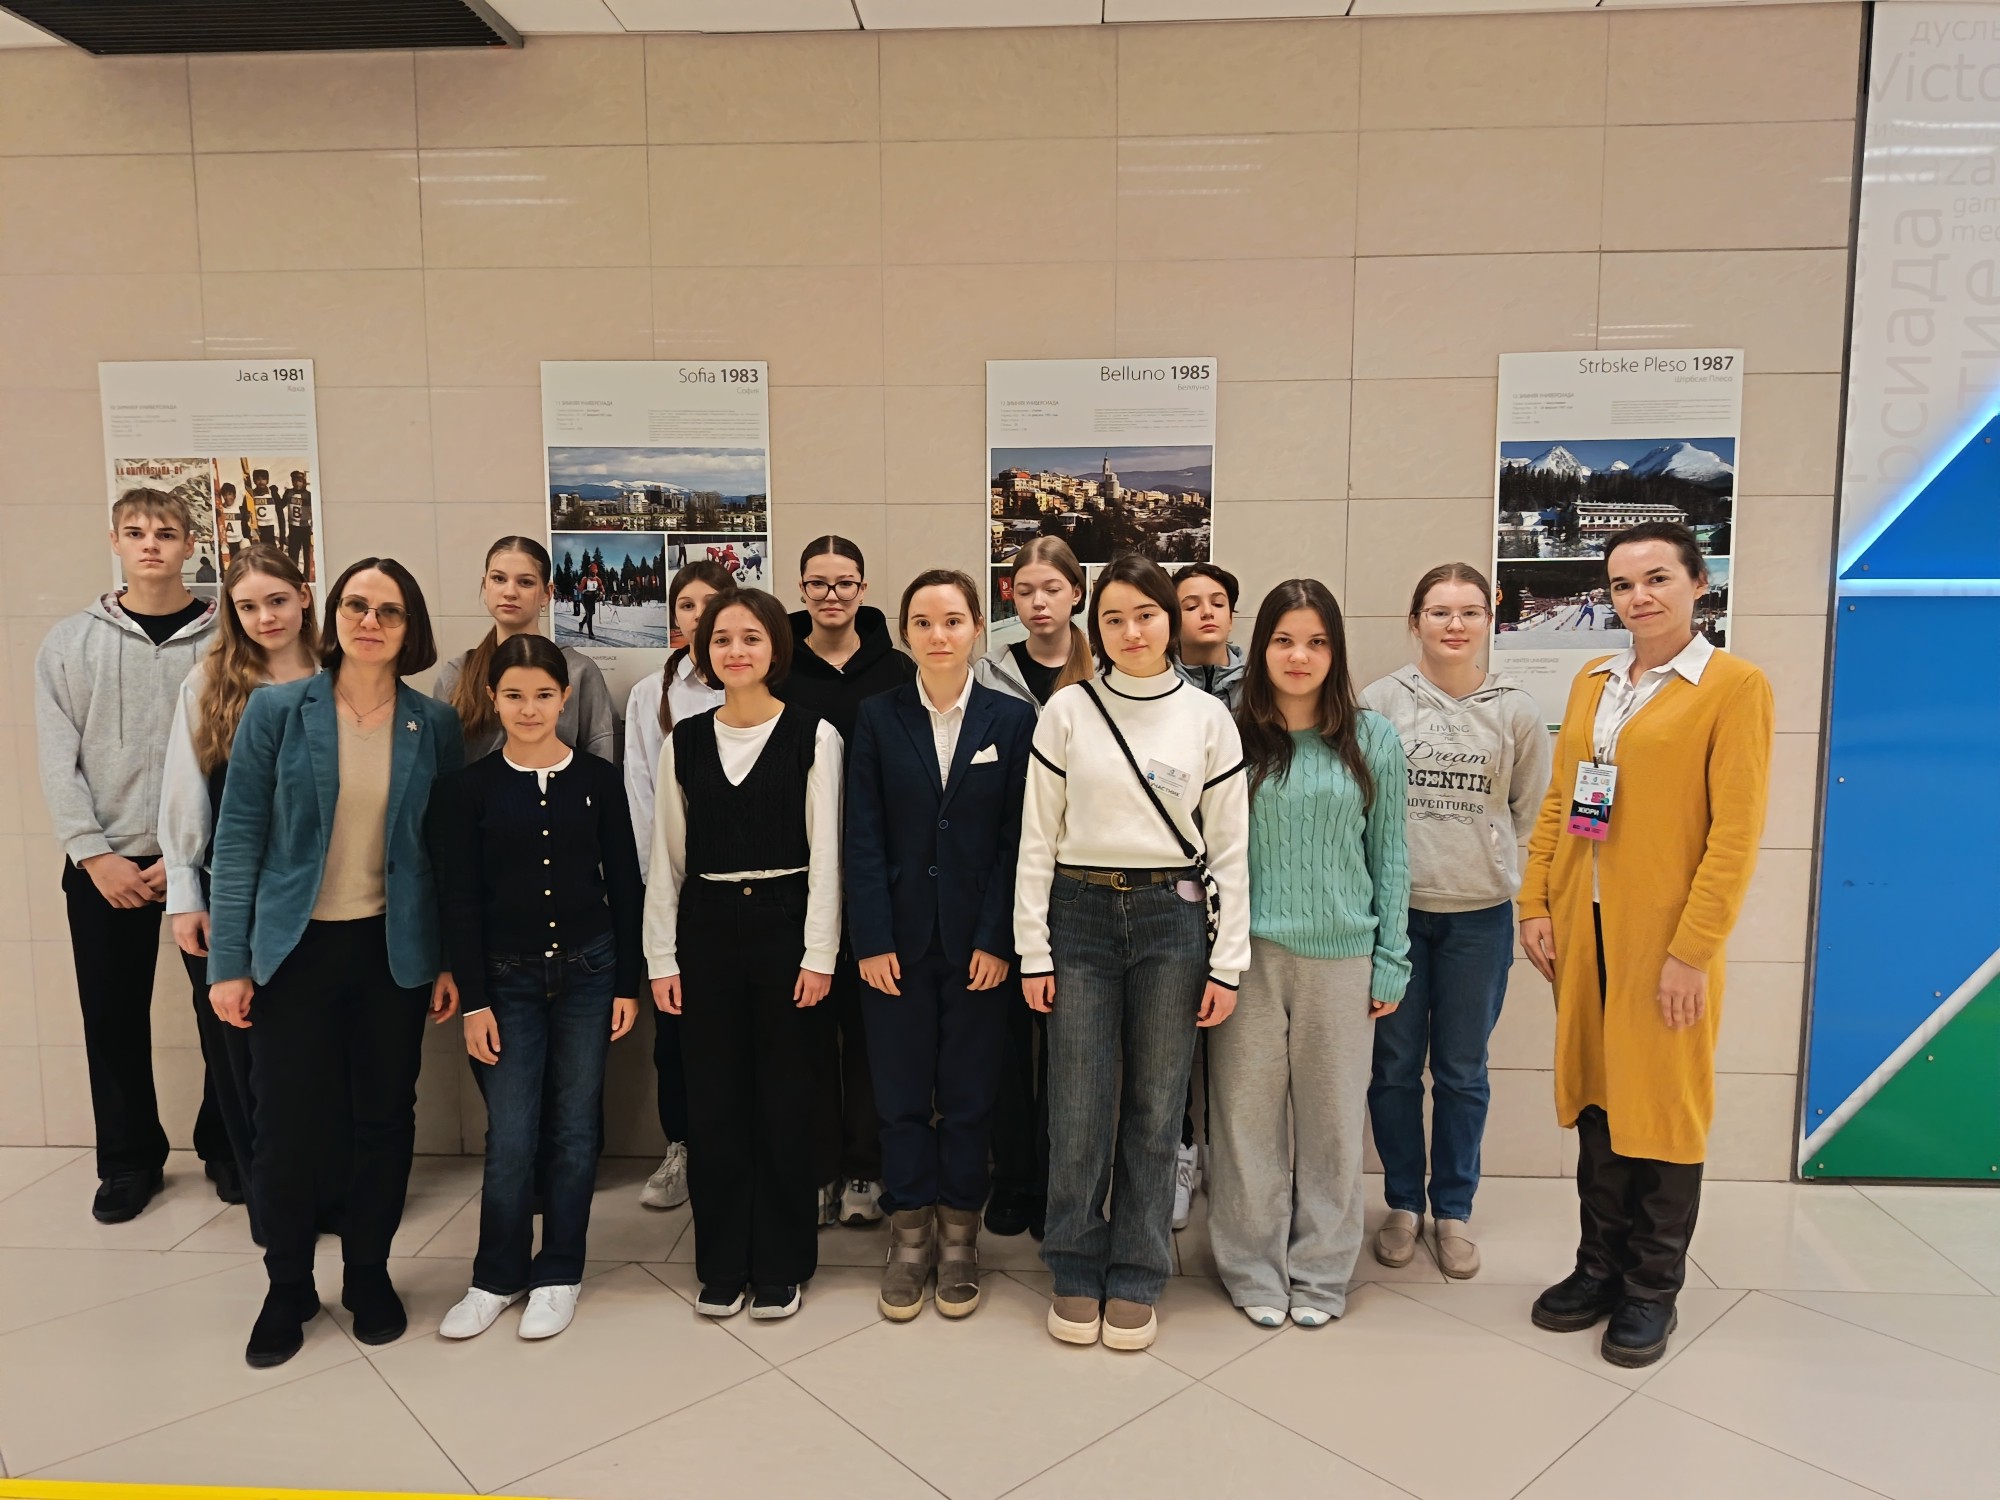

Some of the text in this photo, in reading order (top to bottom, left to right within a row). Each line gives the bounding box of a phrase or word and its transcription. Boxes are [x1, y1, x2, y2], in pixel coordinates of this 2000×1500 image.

[1579, 355, 1734, 374] Strbske Pleso 1987
[1875, 208, 1950, 512] рсиада
[236, 368, 304, 382] Jaca 1981
[679, 367, 759, 384] Sofia 1983
[1100, 365, 1210, 382] Belluno 1985
[736, 387, 760, 395] София
[1177, 383, 1210, 392] Беллуно
[256, 506, 302, 519] C B
[225, 521, 235, 534] A
[1429, 723, 1470, 733] LIVING
[1404, 740, 1491, 768] Dream
